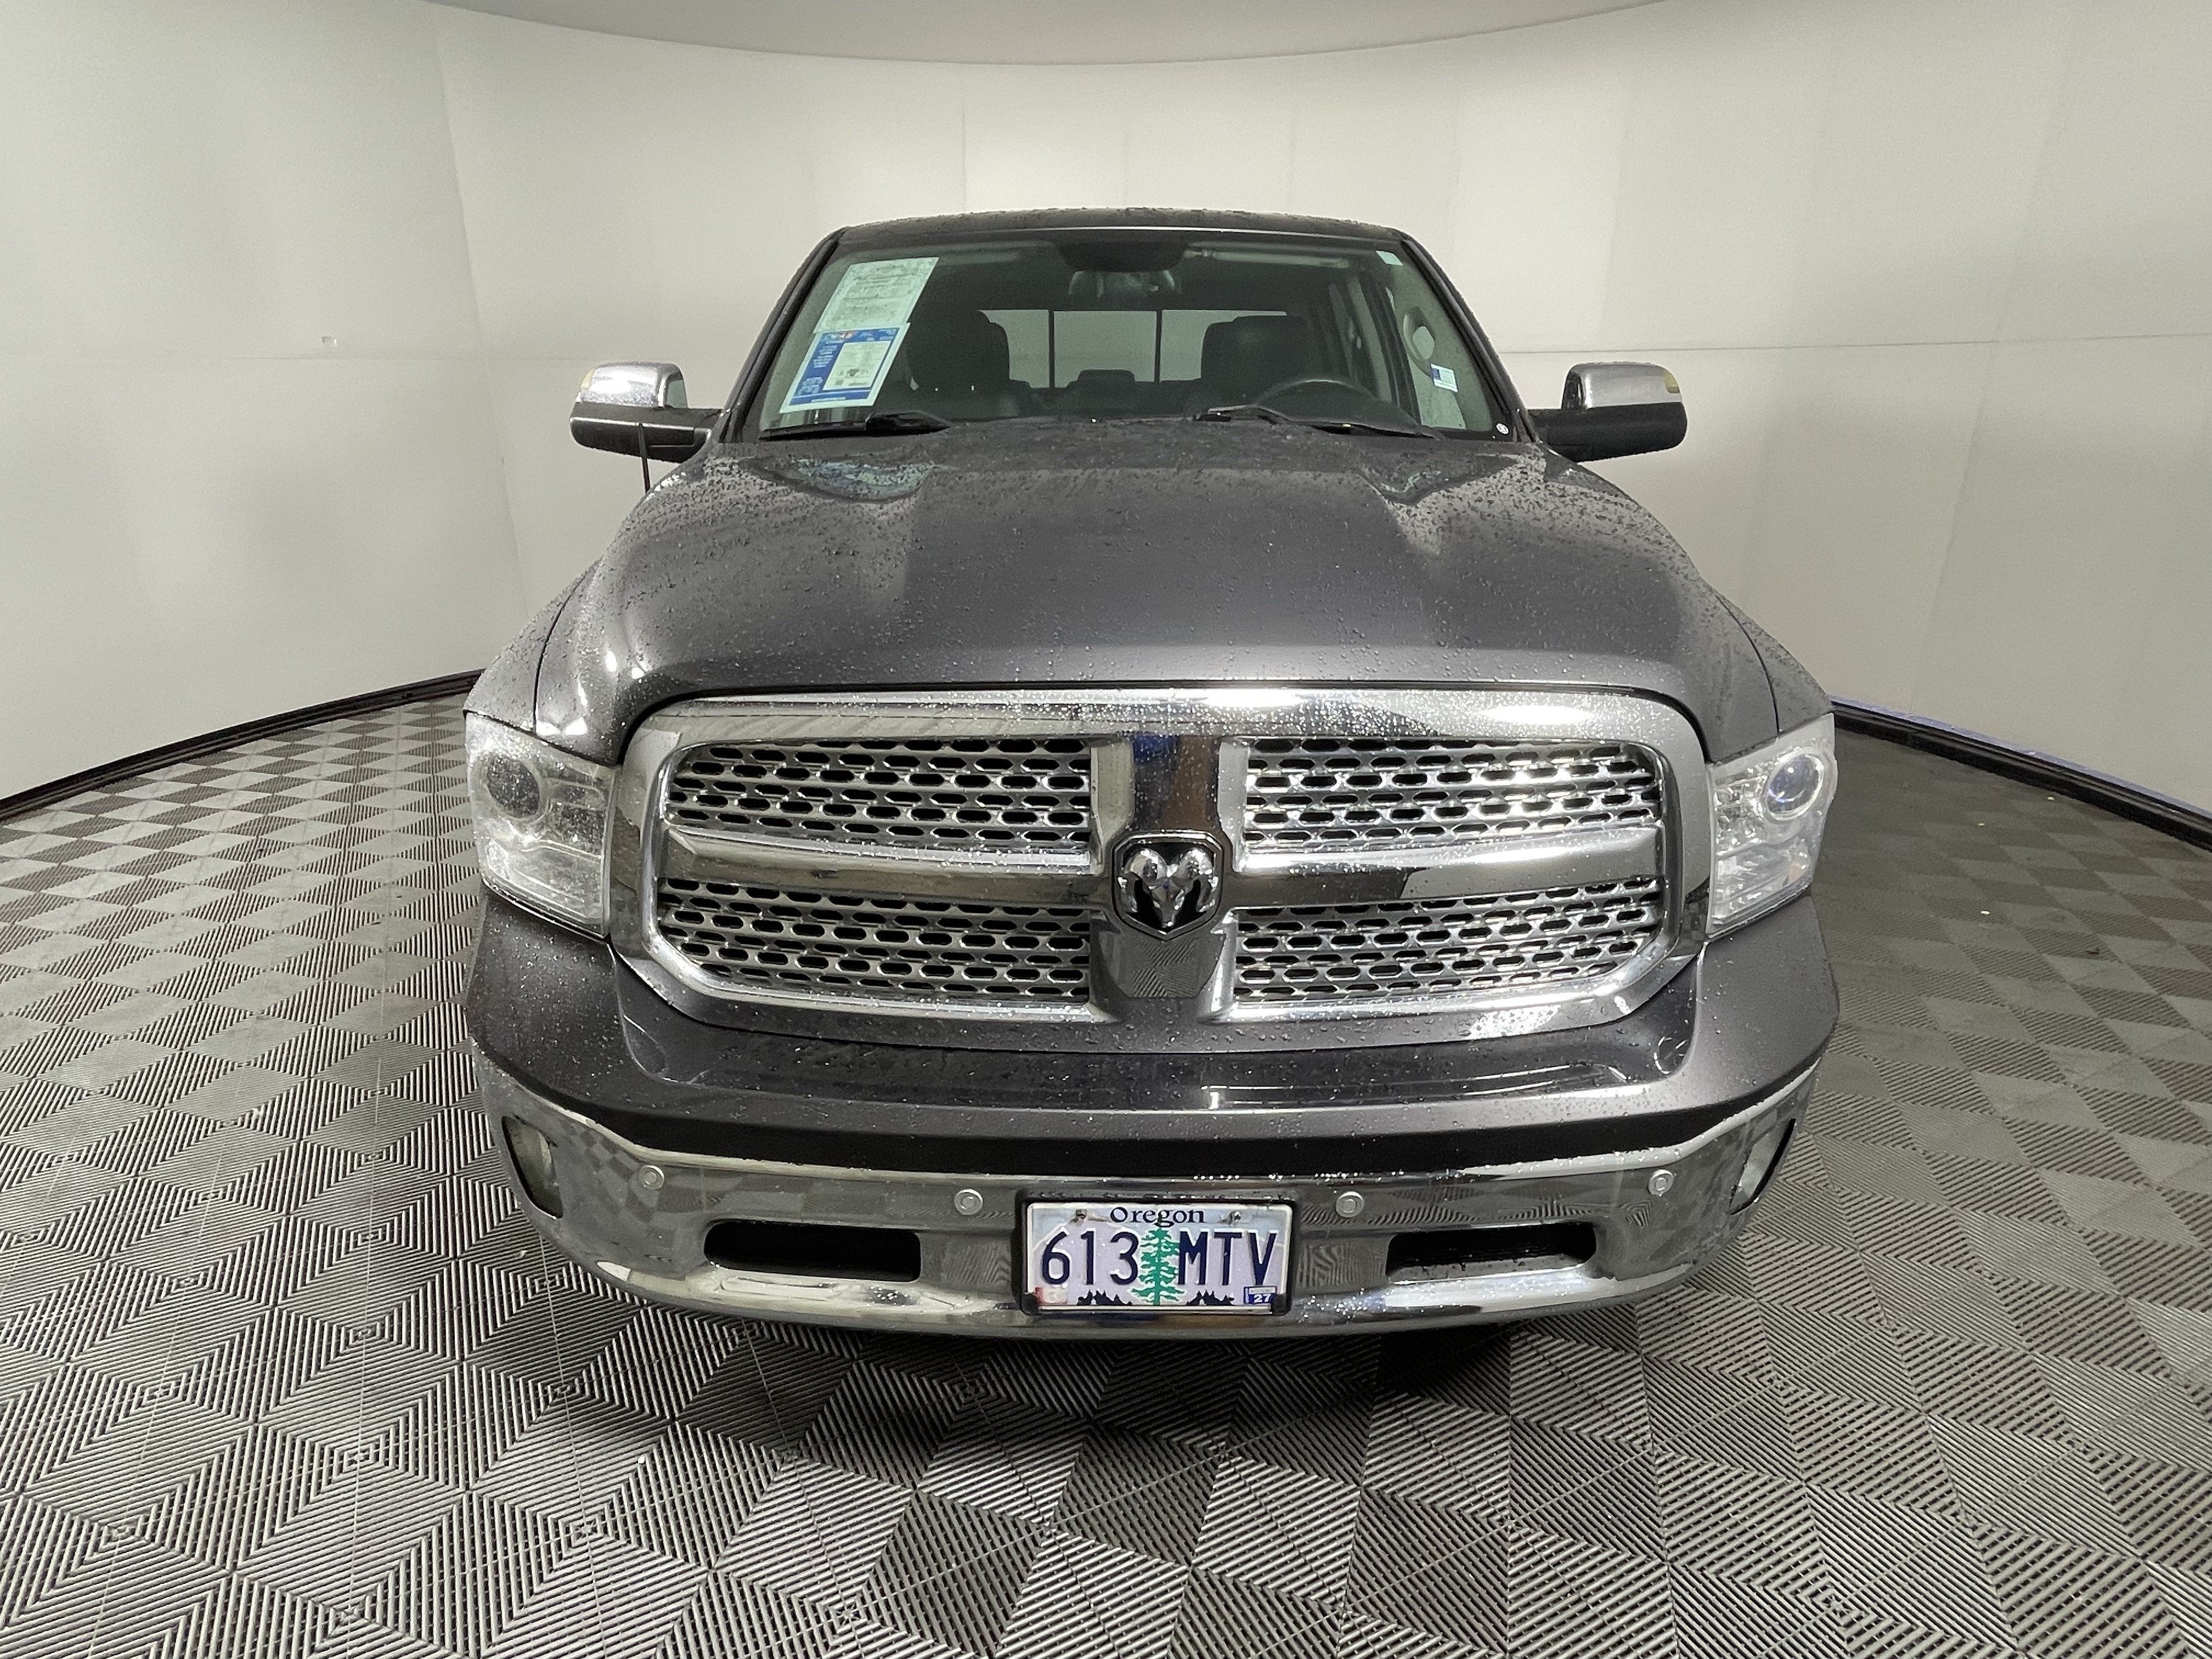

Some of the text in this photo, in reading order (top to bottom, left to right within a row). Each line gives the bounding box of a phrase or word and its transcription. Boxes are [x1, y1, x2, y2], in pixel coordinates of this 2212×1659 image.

[1110, 1206, 1206, 1228] Oregon
[1042, 1231, 1278, 1285] 613 MTV
[1254, 1294, 1272, 1303] 27
